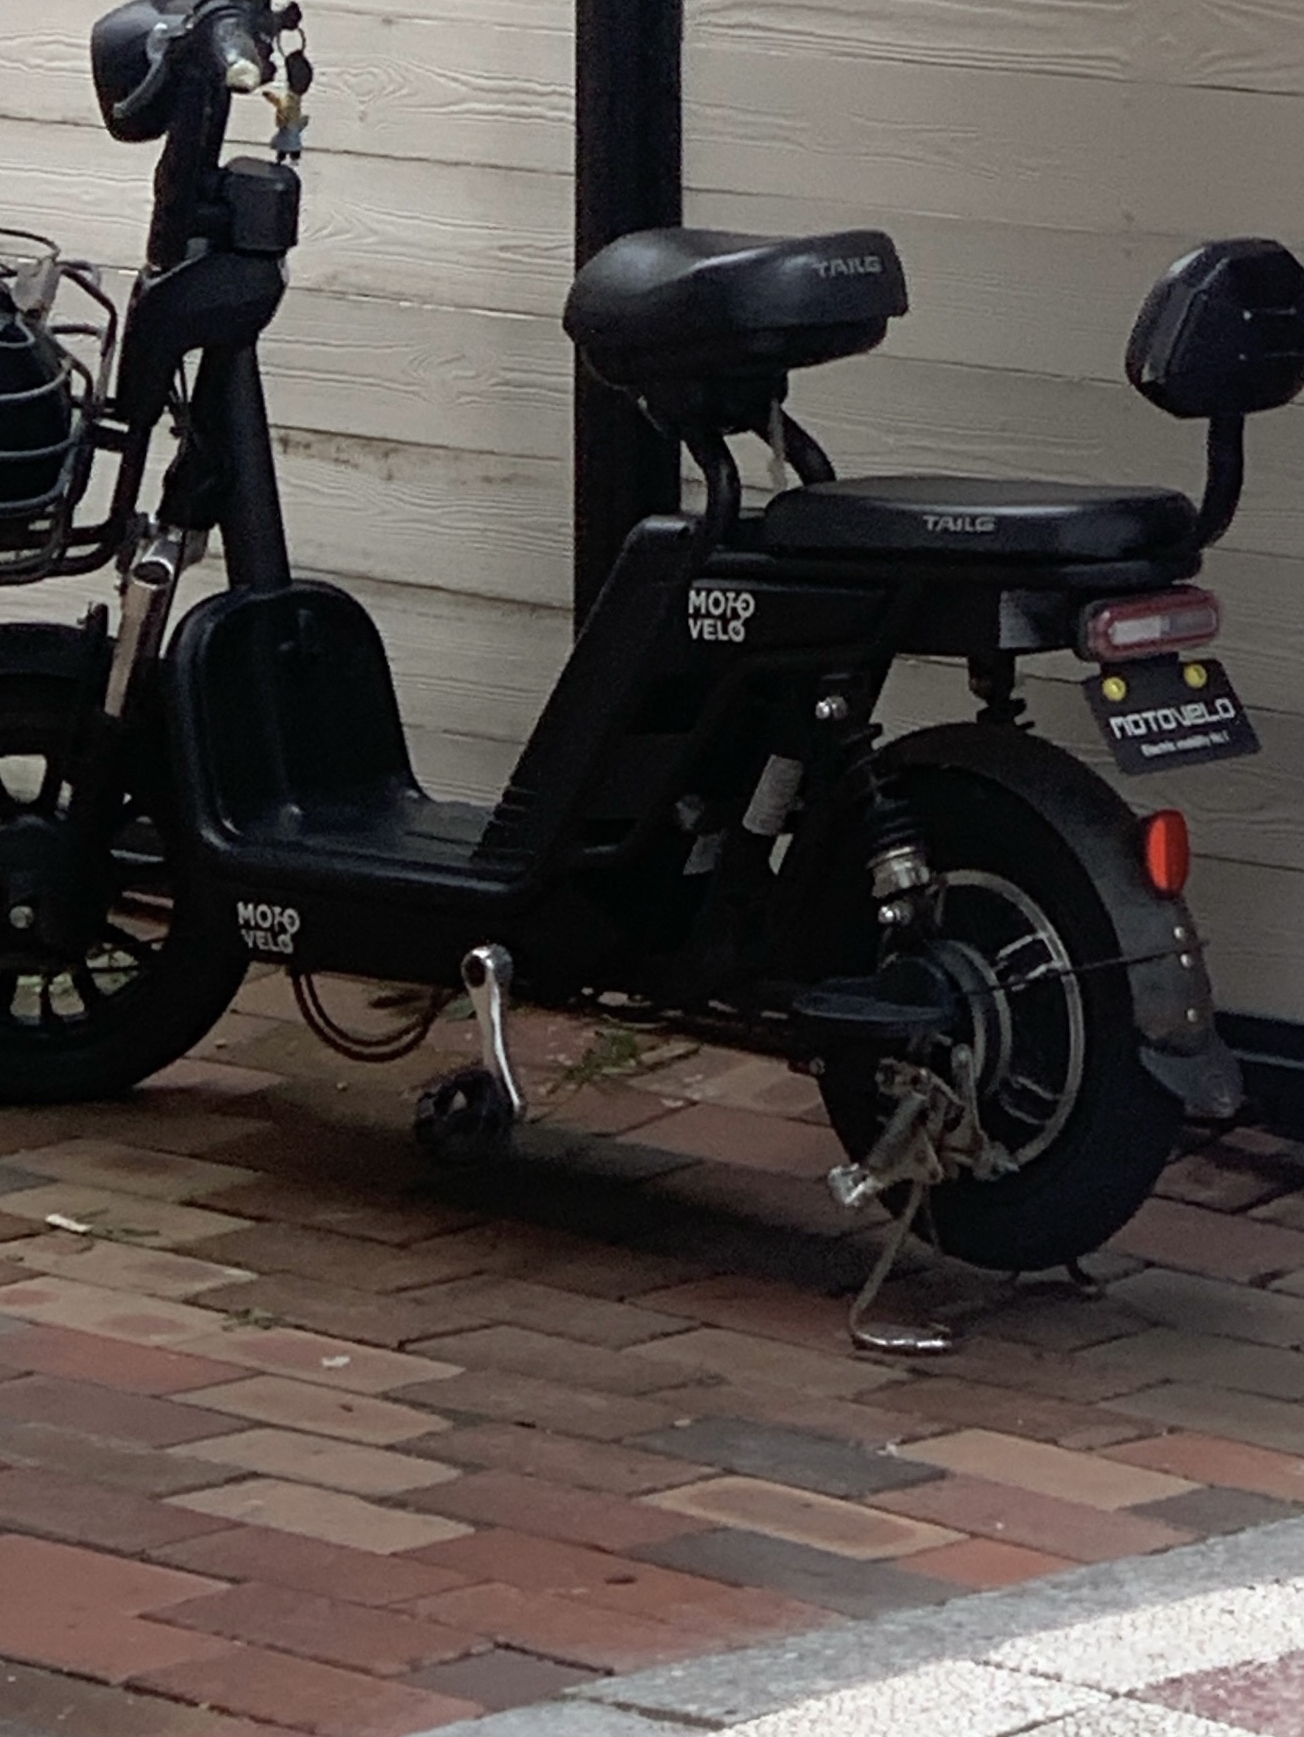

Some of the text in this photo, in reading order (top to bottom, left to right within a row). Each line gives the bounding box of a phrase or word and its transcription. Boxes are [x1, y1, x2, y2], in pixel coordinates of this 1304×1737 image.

[811, 254, 884, 279] TAILG
[922, 513, 996, 534] TAILG
[687, 589, 756, 619] MOTO
[687, 616, 746, 642] VELO
[236, 901, 300, 935] MOTO
[240, 928, 294, 955] VELO
